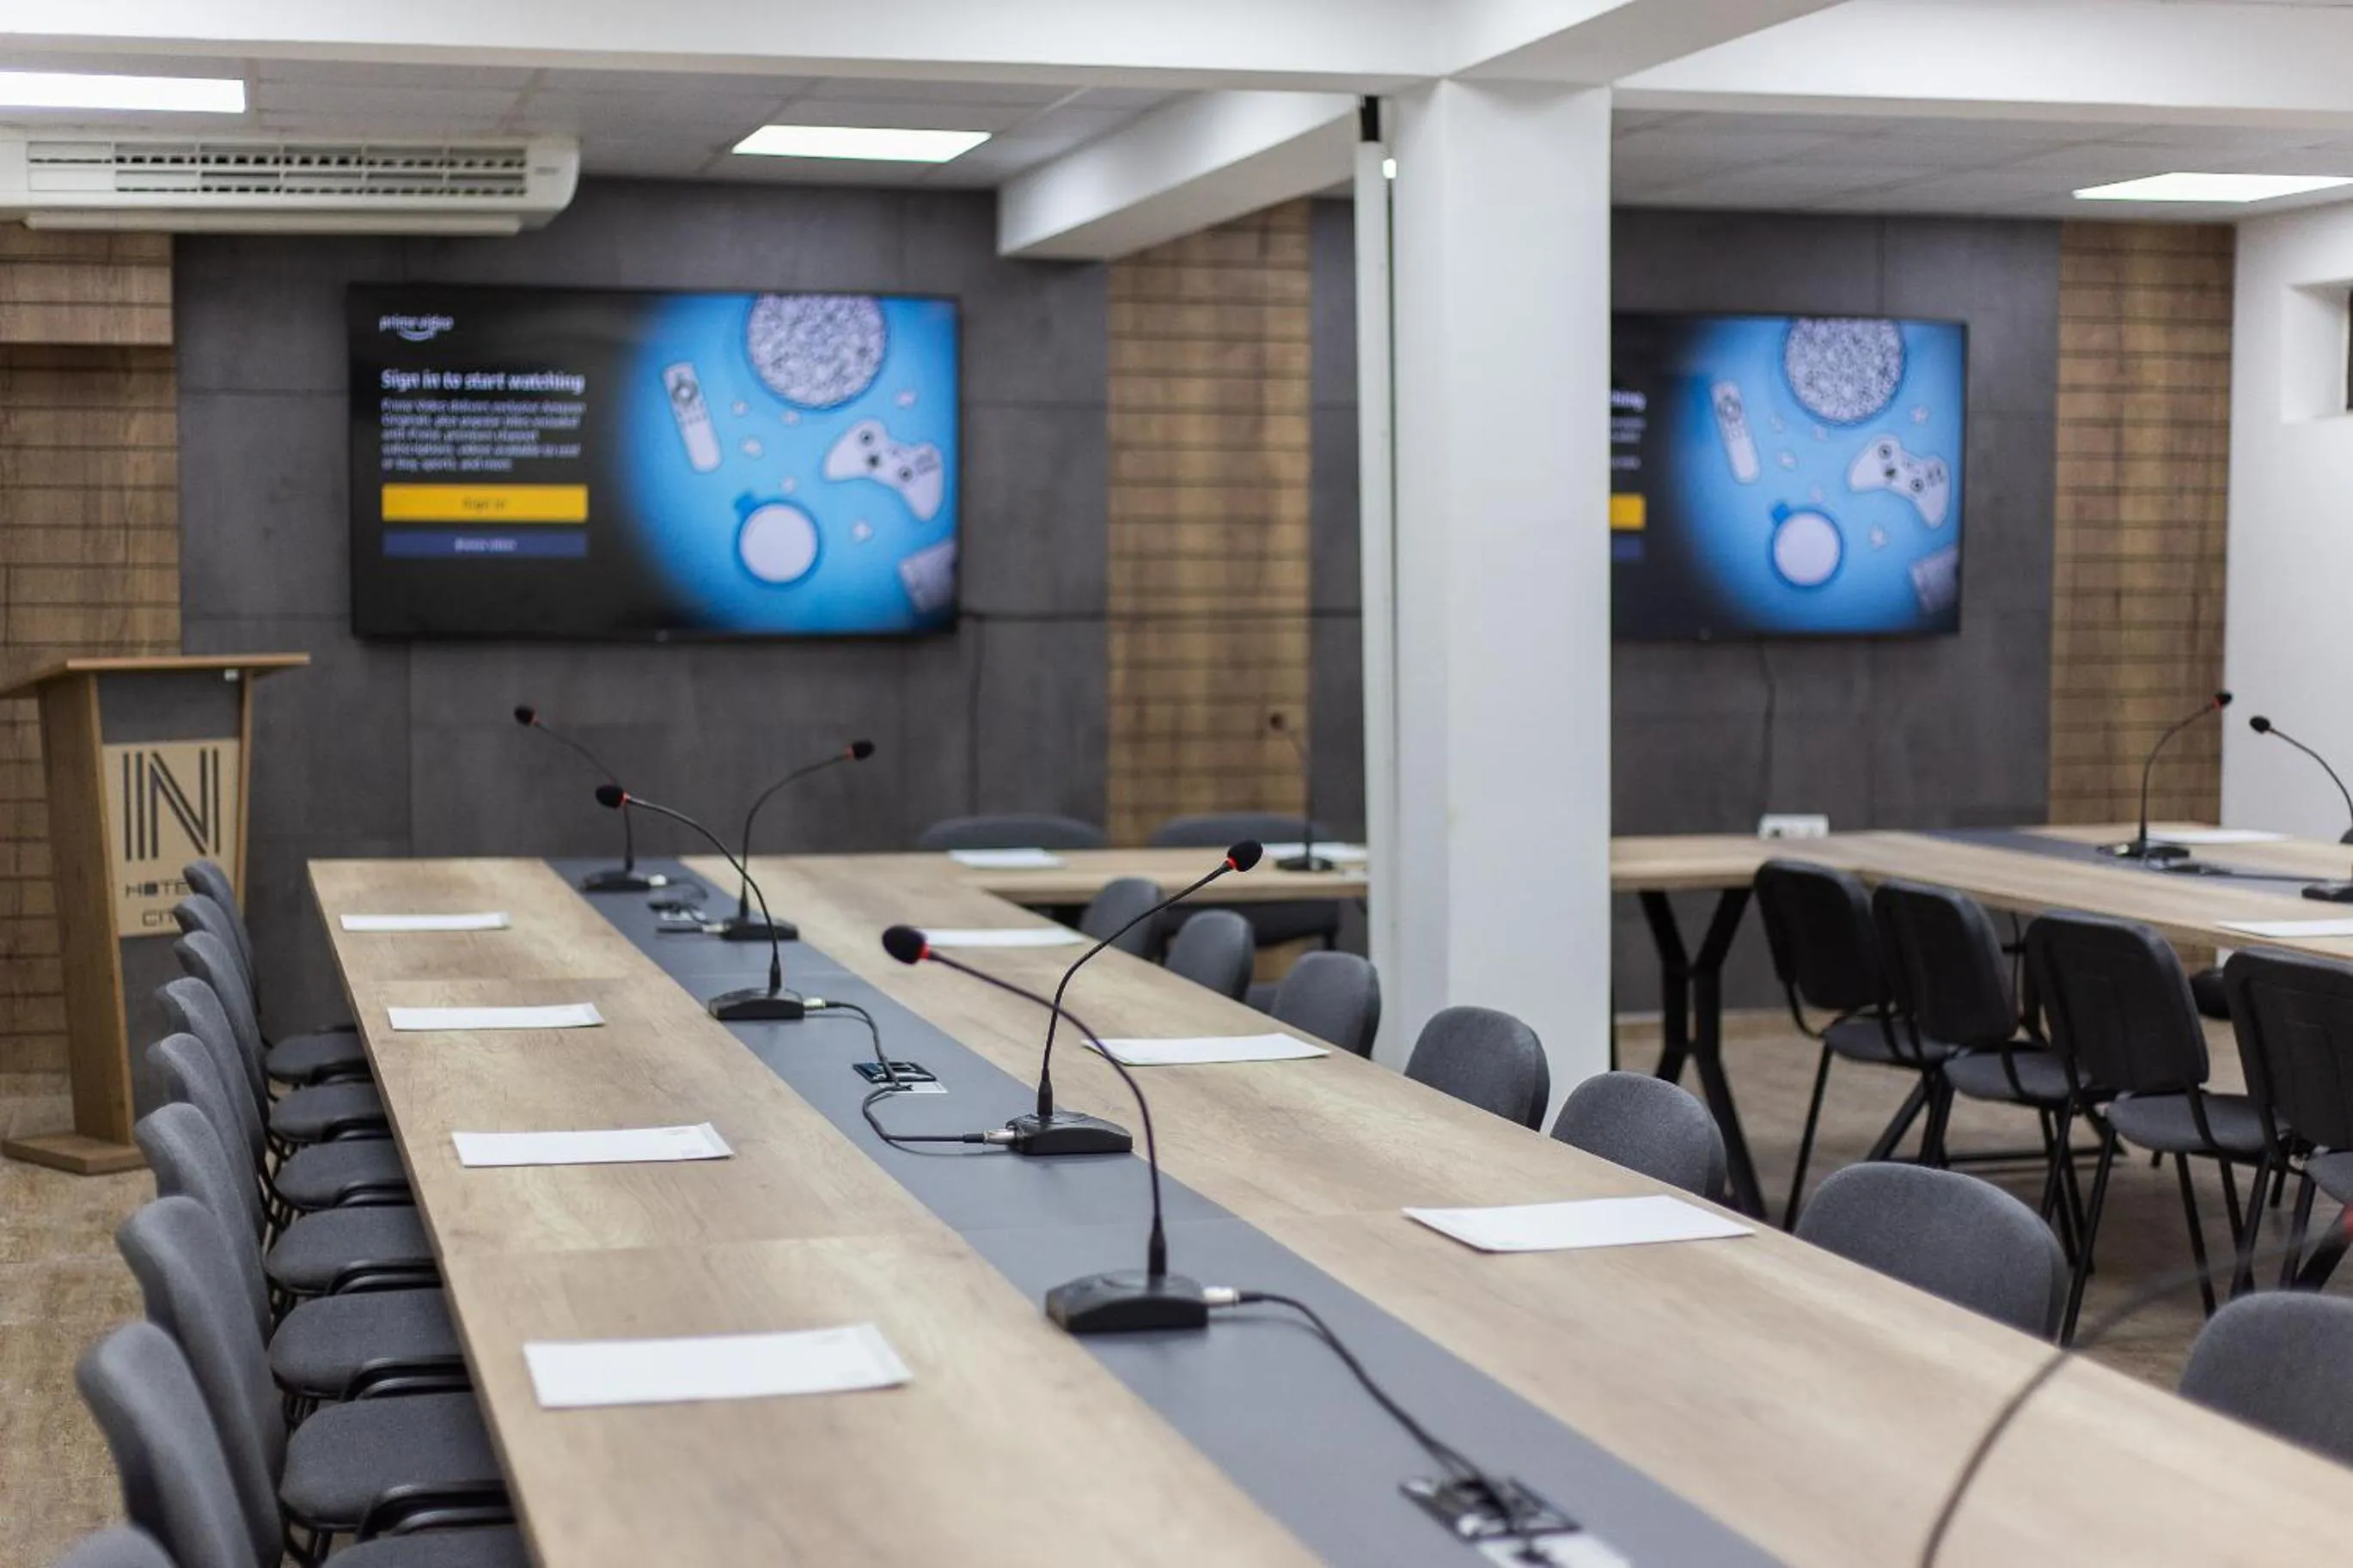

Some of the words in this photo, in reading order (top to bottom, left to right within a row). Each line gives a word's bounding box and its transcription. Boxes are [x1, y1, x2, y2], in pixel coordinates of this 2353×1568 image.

[381, 368, 420, 393] Sign
[422, 368, 441, 389] in
[443, 370, 463, 390] to
[464, 371, 505, 390] start
[507, 369, 586, 395] watching
[125, 878, 191, 899] HOTE
[141, 907, 174, 927] CIT
